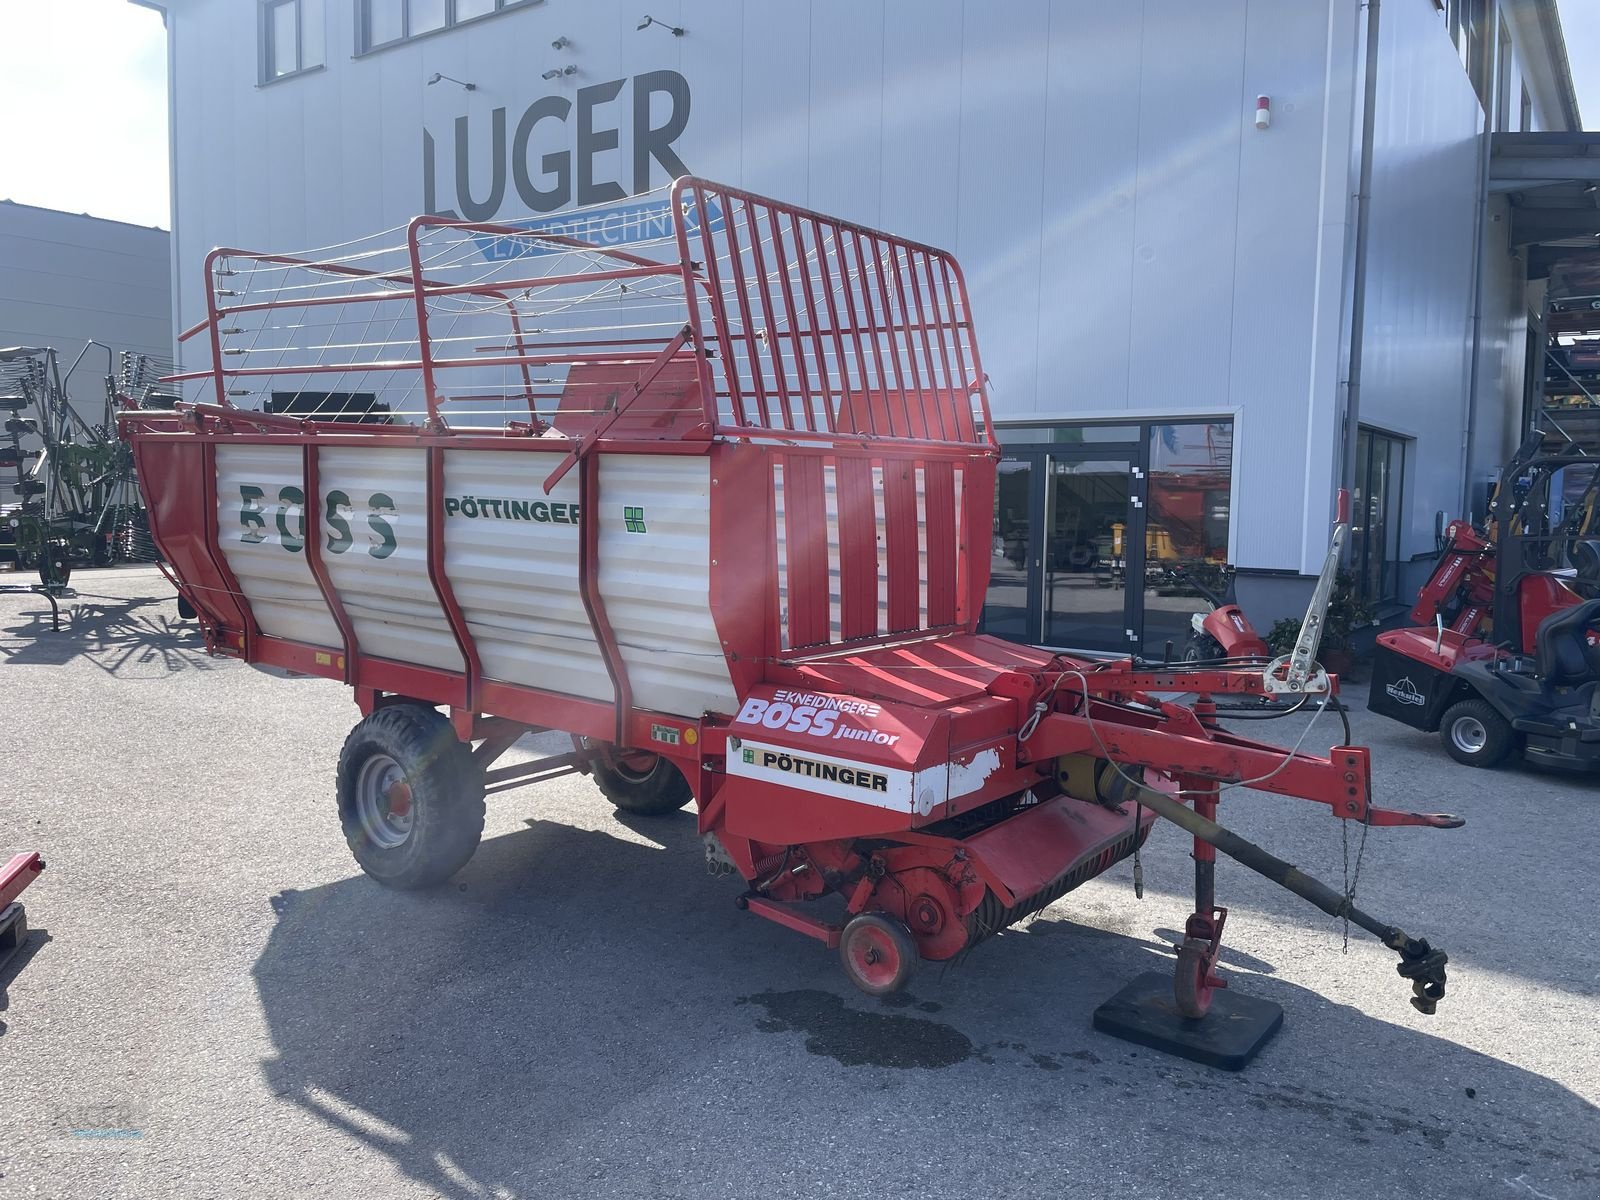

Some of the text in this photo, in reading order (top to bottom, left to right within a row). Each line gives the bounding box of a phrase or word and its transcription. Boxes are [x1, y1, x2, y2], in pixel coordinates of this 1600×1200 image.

[423, 69, 693, 231] LUGER
[240, 485, 398, 560] BOSS
[736, 697, 900, 746] BOSS junior
[785, 691, 867, 715] KNEIDINGER
[764, 753, 888, 792] PÖTTINGER
